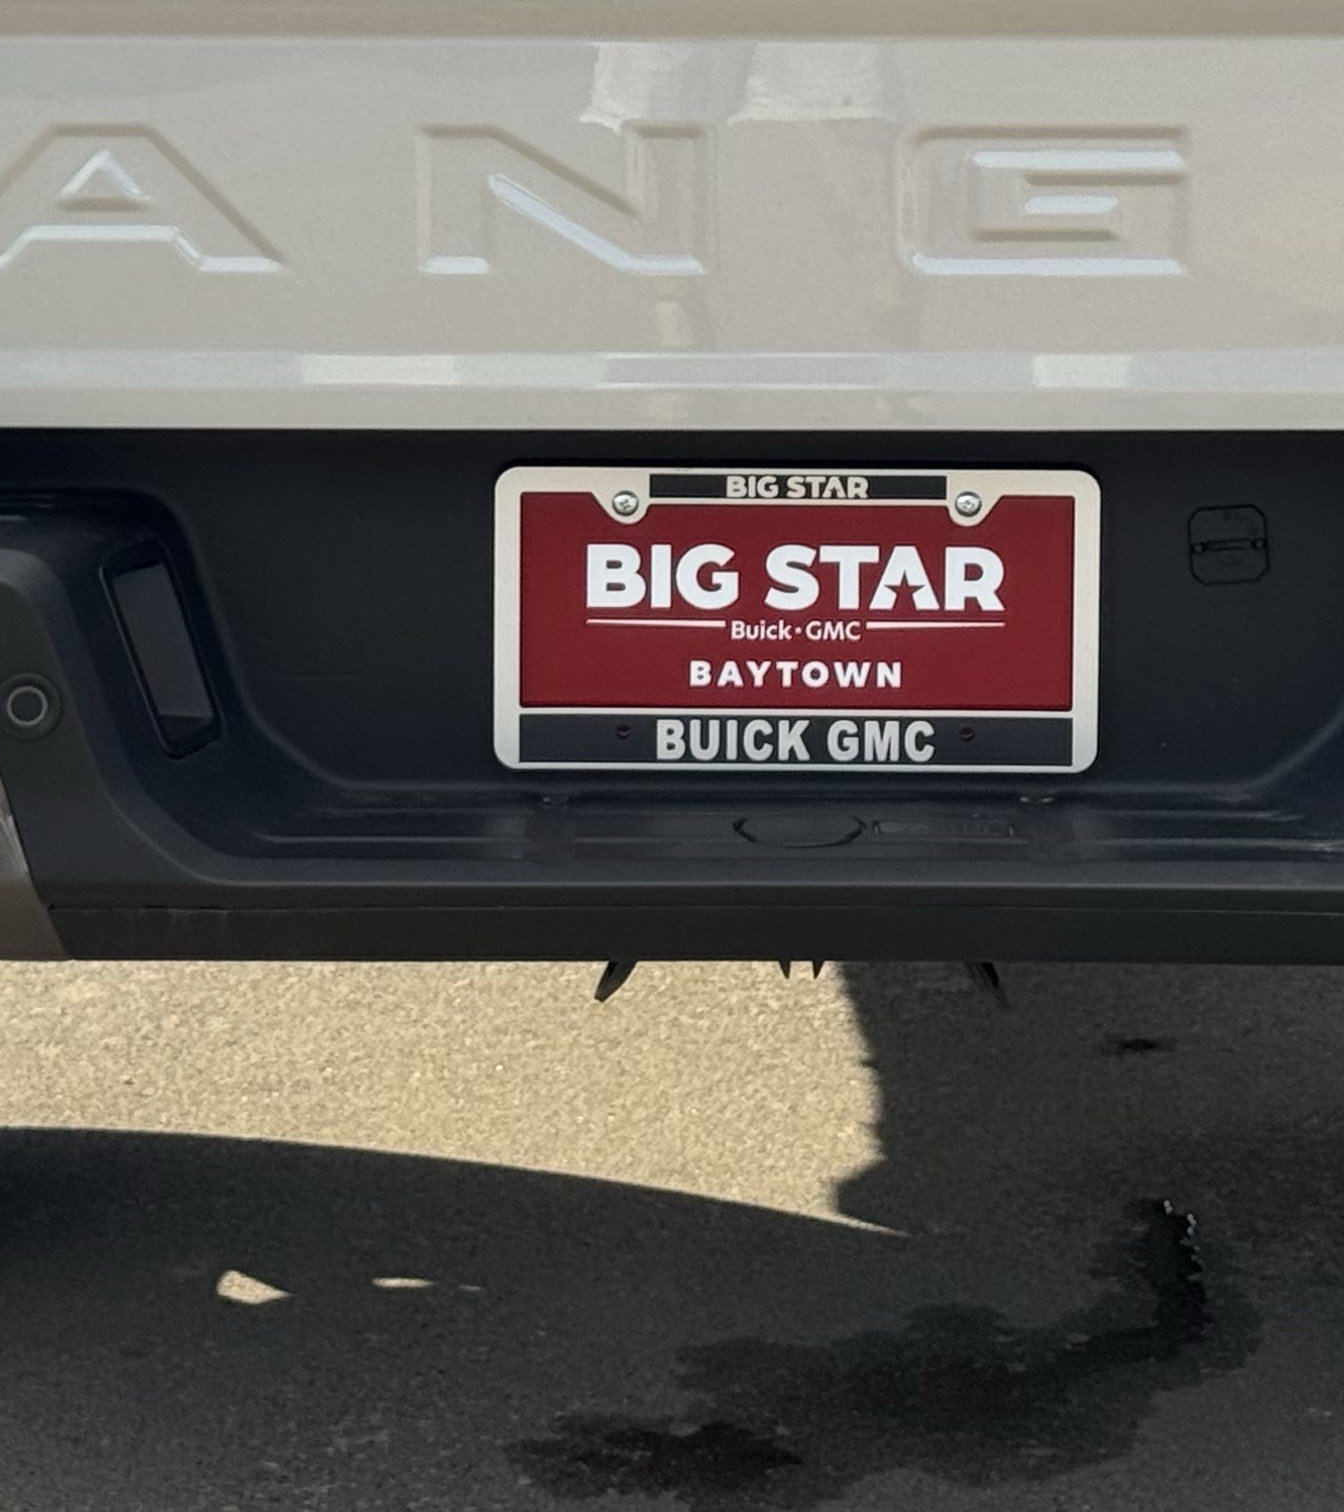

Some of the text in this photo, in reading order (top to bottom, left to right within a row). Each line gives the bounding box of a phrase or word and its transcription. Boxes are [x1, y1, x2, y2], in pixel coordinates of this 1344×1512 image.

[725, 475, 869, 499] BIG STAR
[586, 544, 1005, 612] BIG STAR
[689, 660, 902, 689] BAYTOWN
[656, 718, 936, 763] BUICK GMC
